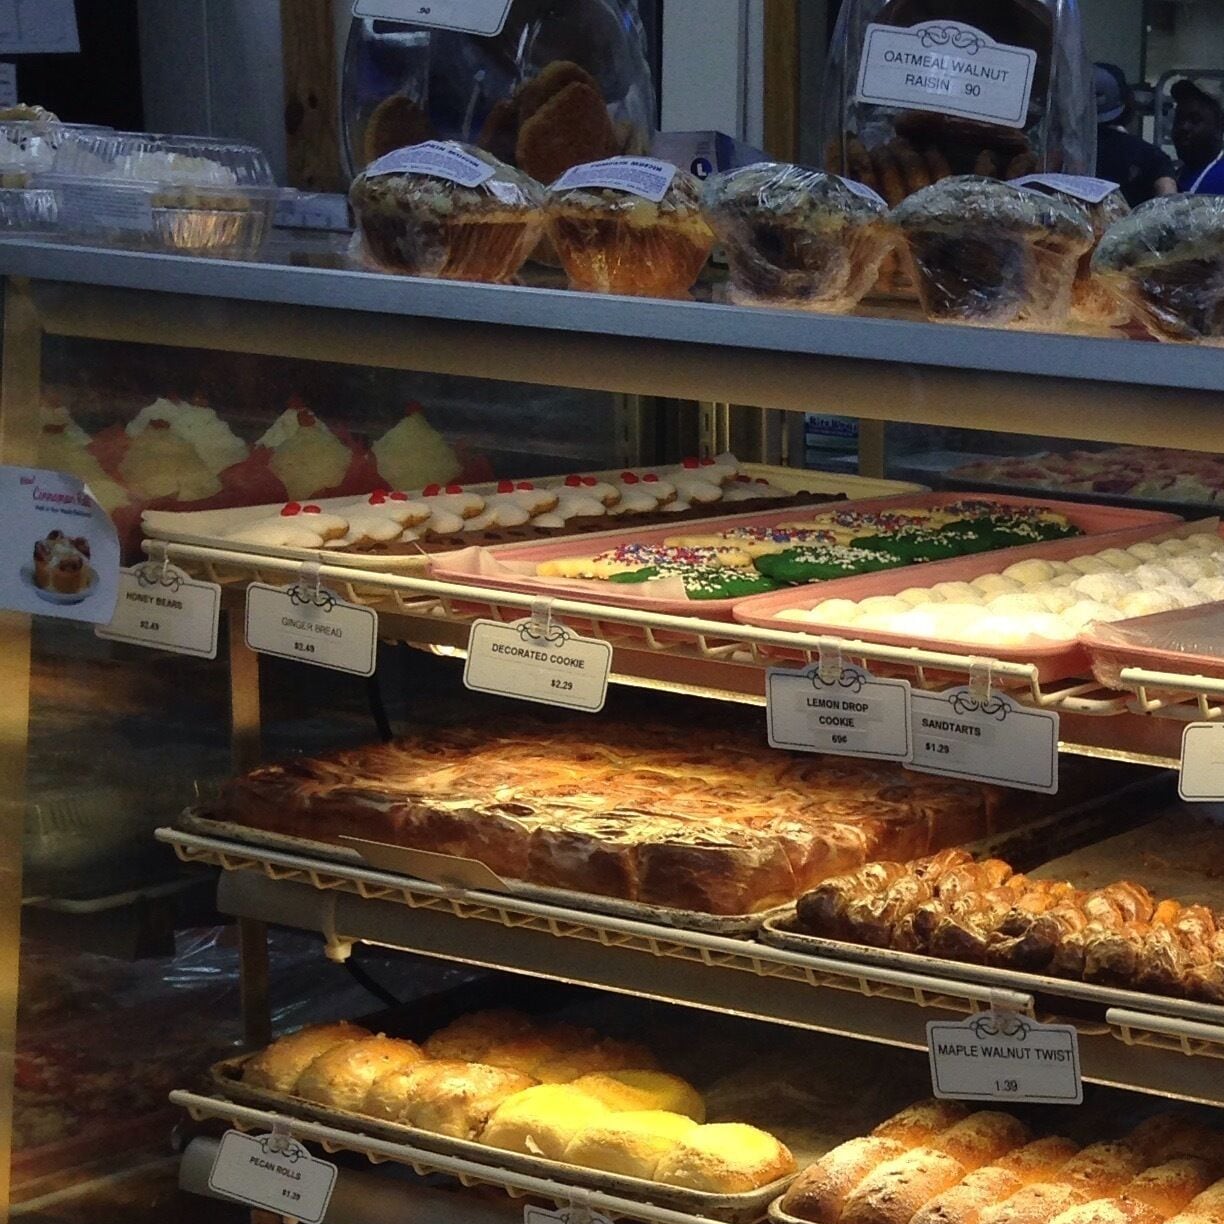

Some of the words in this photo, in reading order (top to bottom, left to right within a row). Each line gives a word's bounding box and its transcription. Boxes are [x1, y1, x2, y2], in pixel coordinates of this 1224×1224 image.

[884, 50, 949, 70] OATMEAL
[951, 60, 1009, 82] WALNUT
[905, 74, 950, 91] RAISIN
[281, 616, 313, 632] GINGER
[314, 623, 343, 638] BREAD
[491, 643, 548, 662] DECORATED
[549, 654, 585, 669] COOKIE
[550, 679, 574, 691] $2.29
[806, 698, 840, 710] LEMON
[842, 701, 869, 713] DROP
[818, 716, 855, 728] COOKIE
[921, 718, 981, 736] SANDTARTS
[925, 742, 950, 754] $1.29
[938, 1044, 979, 1057] MAPLE
[980, 1047, 1032, 1060] WALNUT
[1036, 1049, 1073, 1062] TWIST
[995, 1080, 1018, 1092] 1.39
[249, 1156, 276, 1172] PECAN
[276, 1165, 302, 1181] ROLLS
